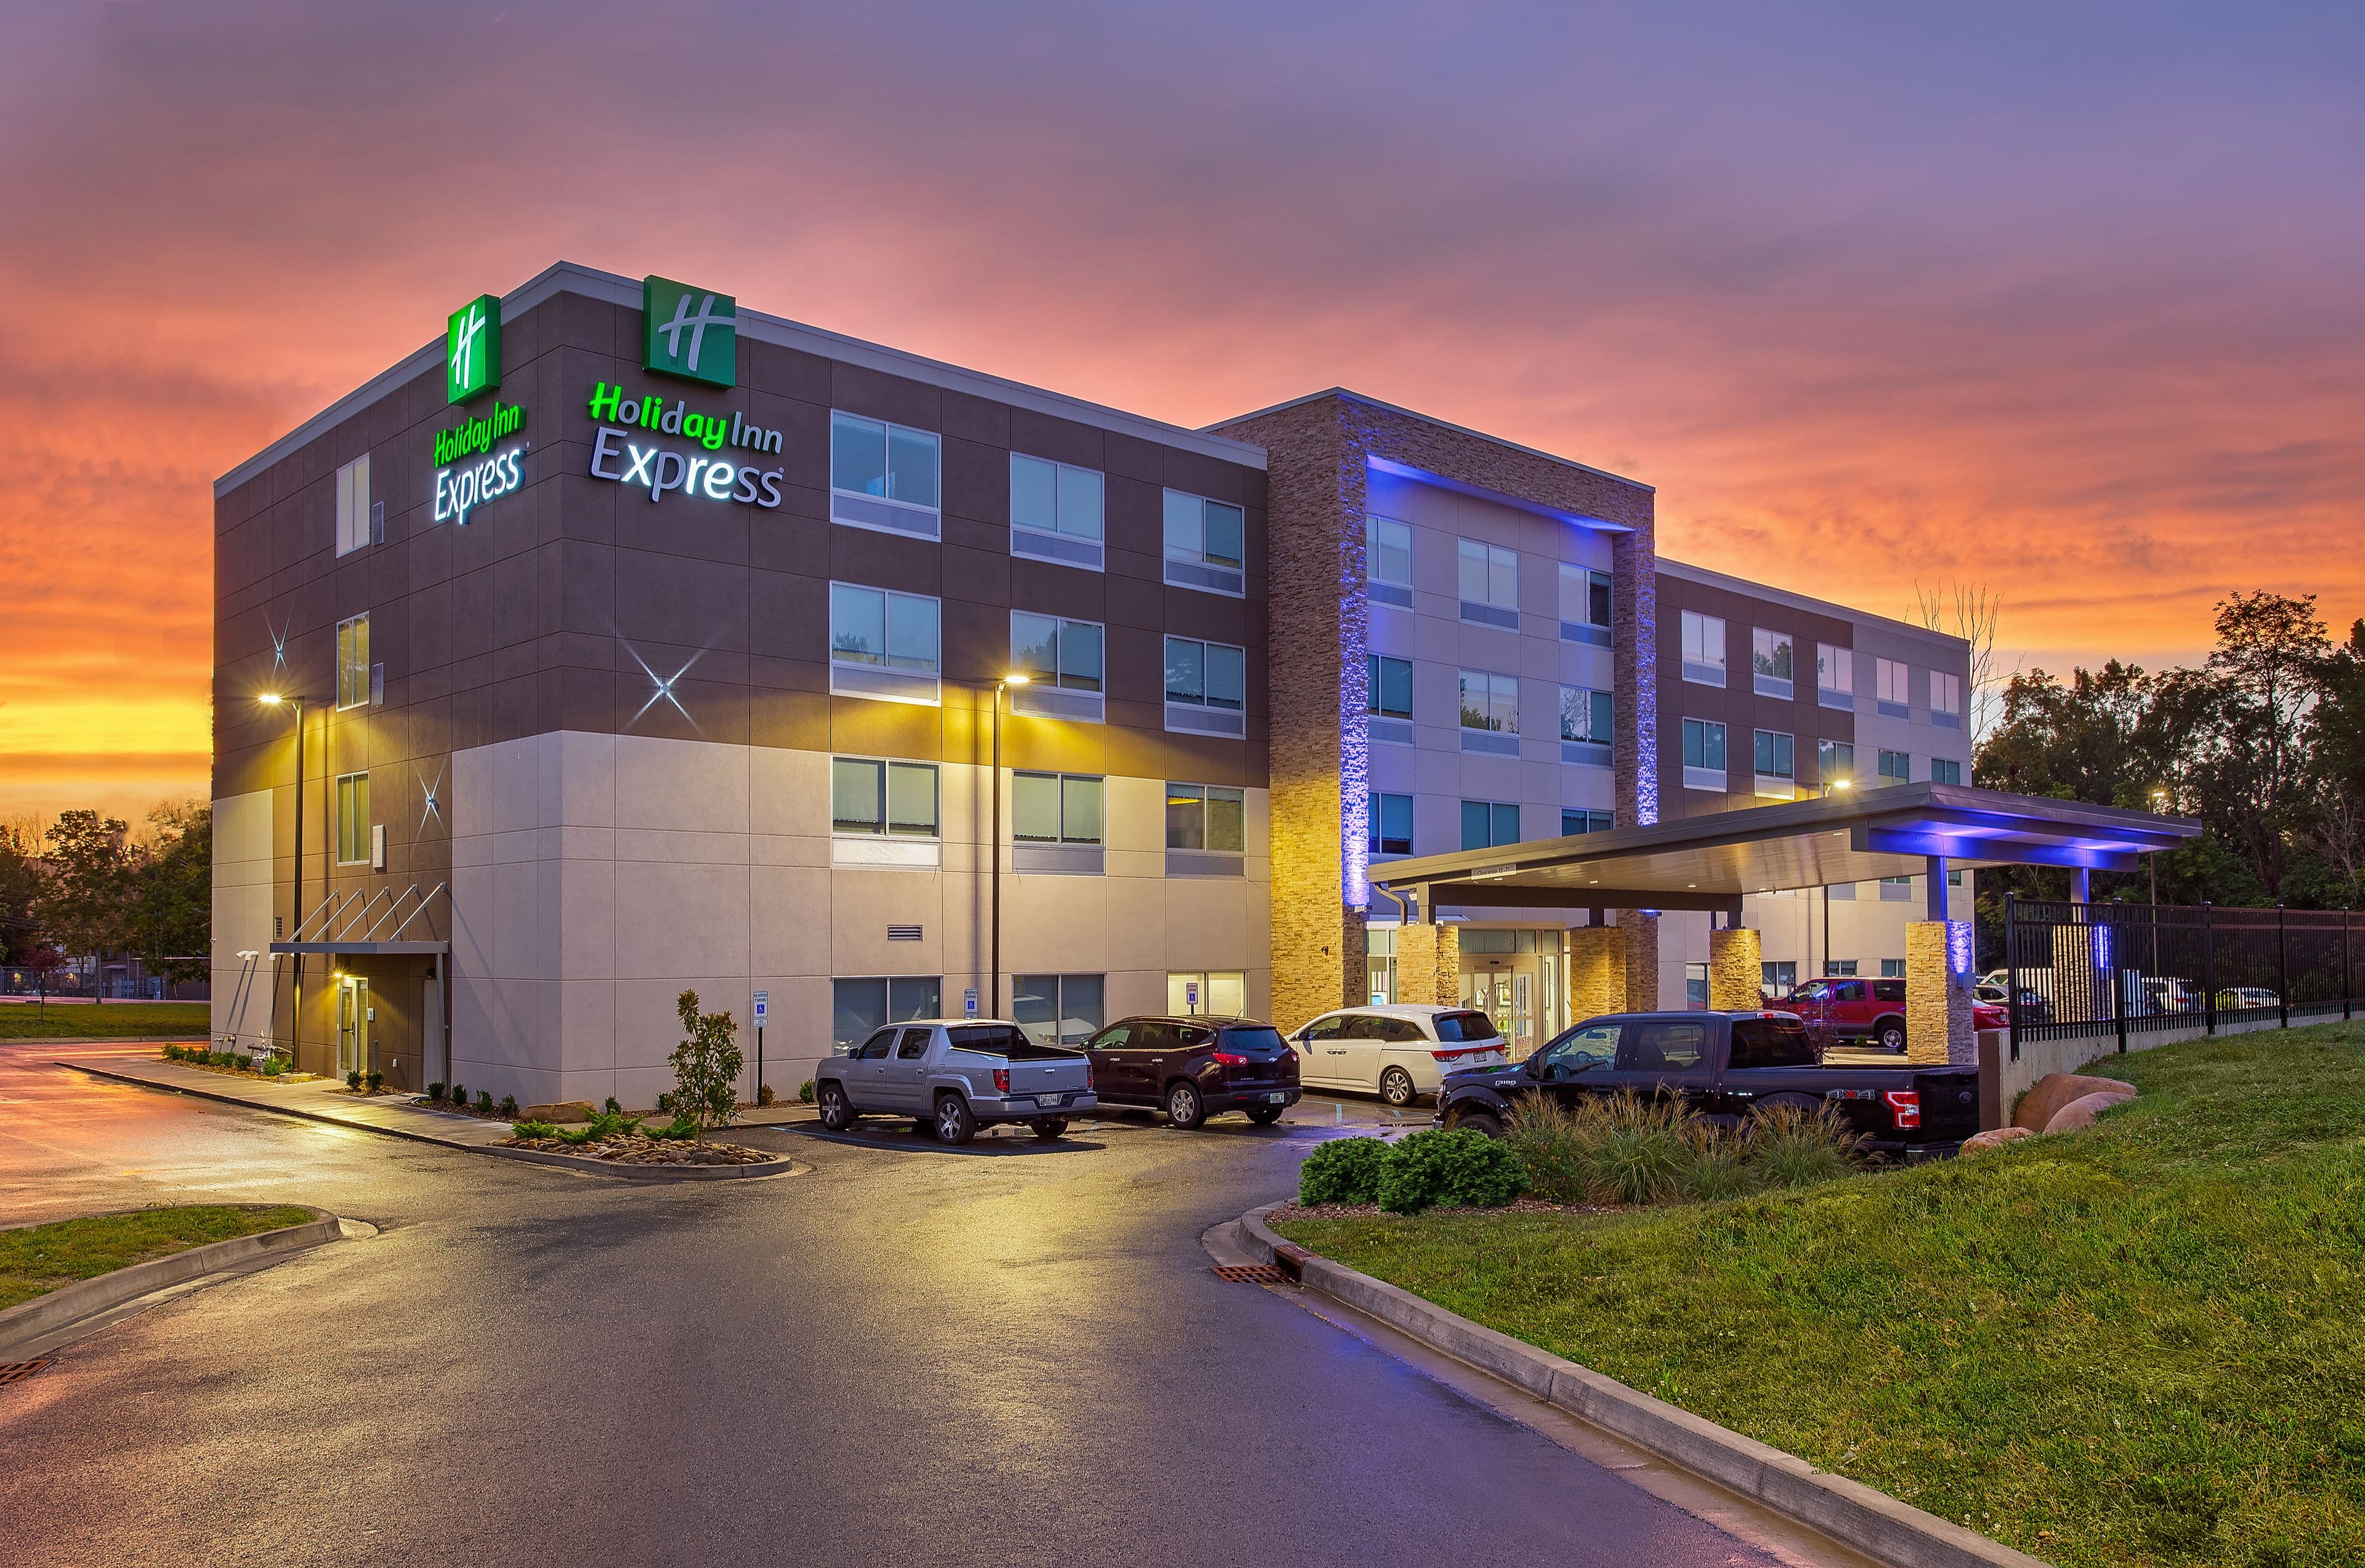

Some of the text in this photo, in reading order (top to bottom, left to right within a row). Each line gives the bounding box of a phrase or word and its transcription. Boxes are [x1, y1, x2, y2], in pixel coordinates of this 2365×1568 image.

[434, 401, 521, 468] Holiday Inn
[589, 381, 783, 454] Holiday Inn
[434, 448, 522, 525] Express
[589, 426, 783, 508] Express
